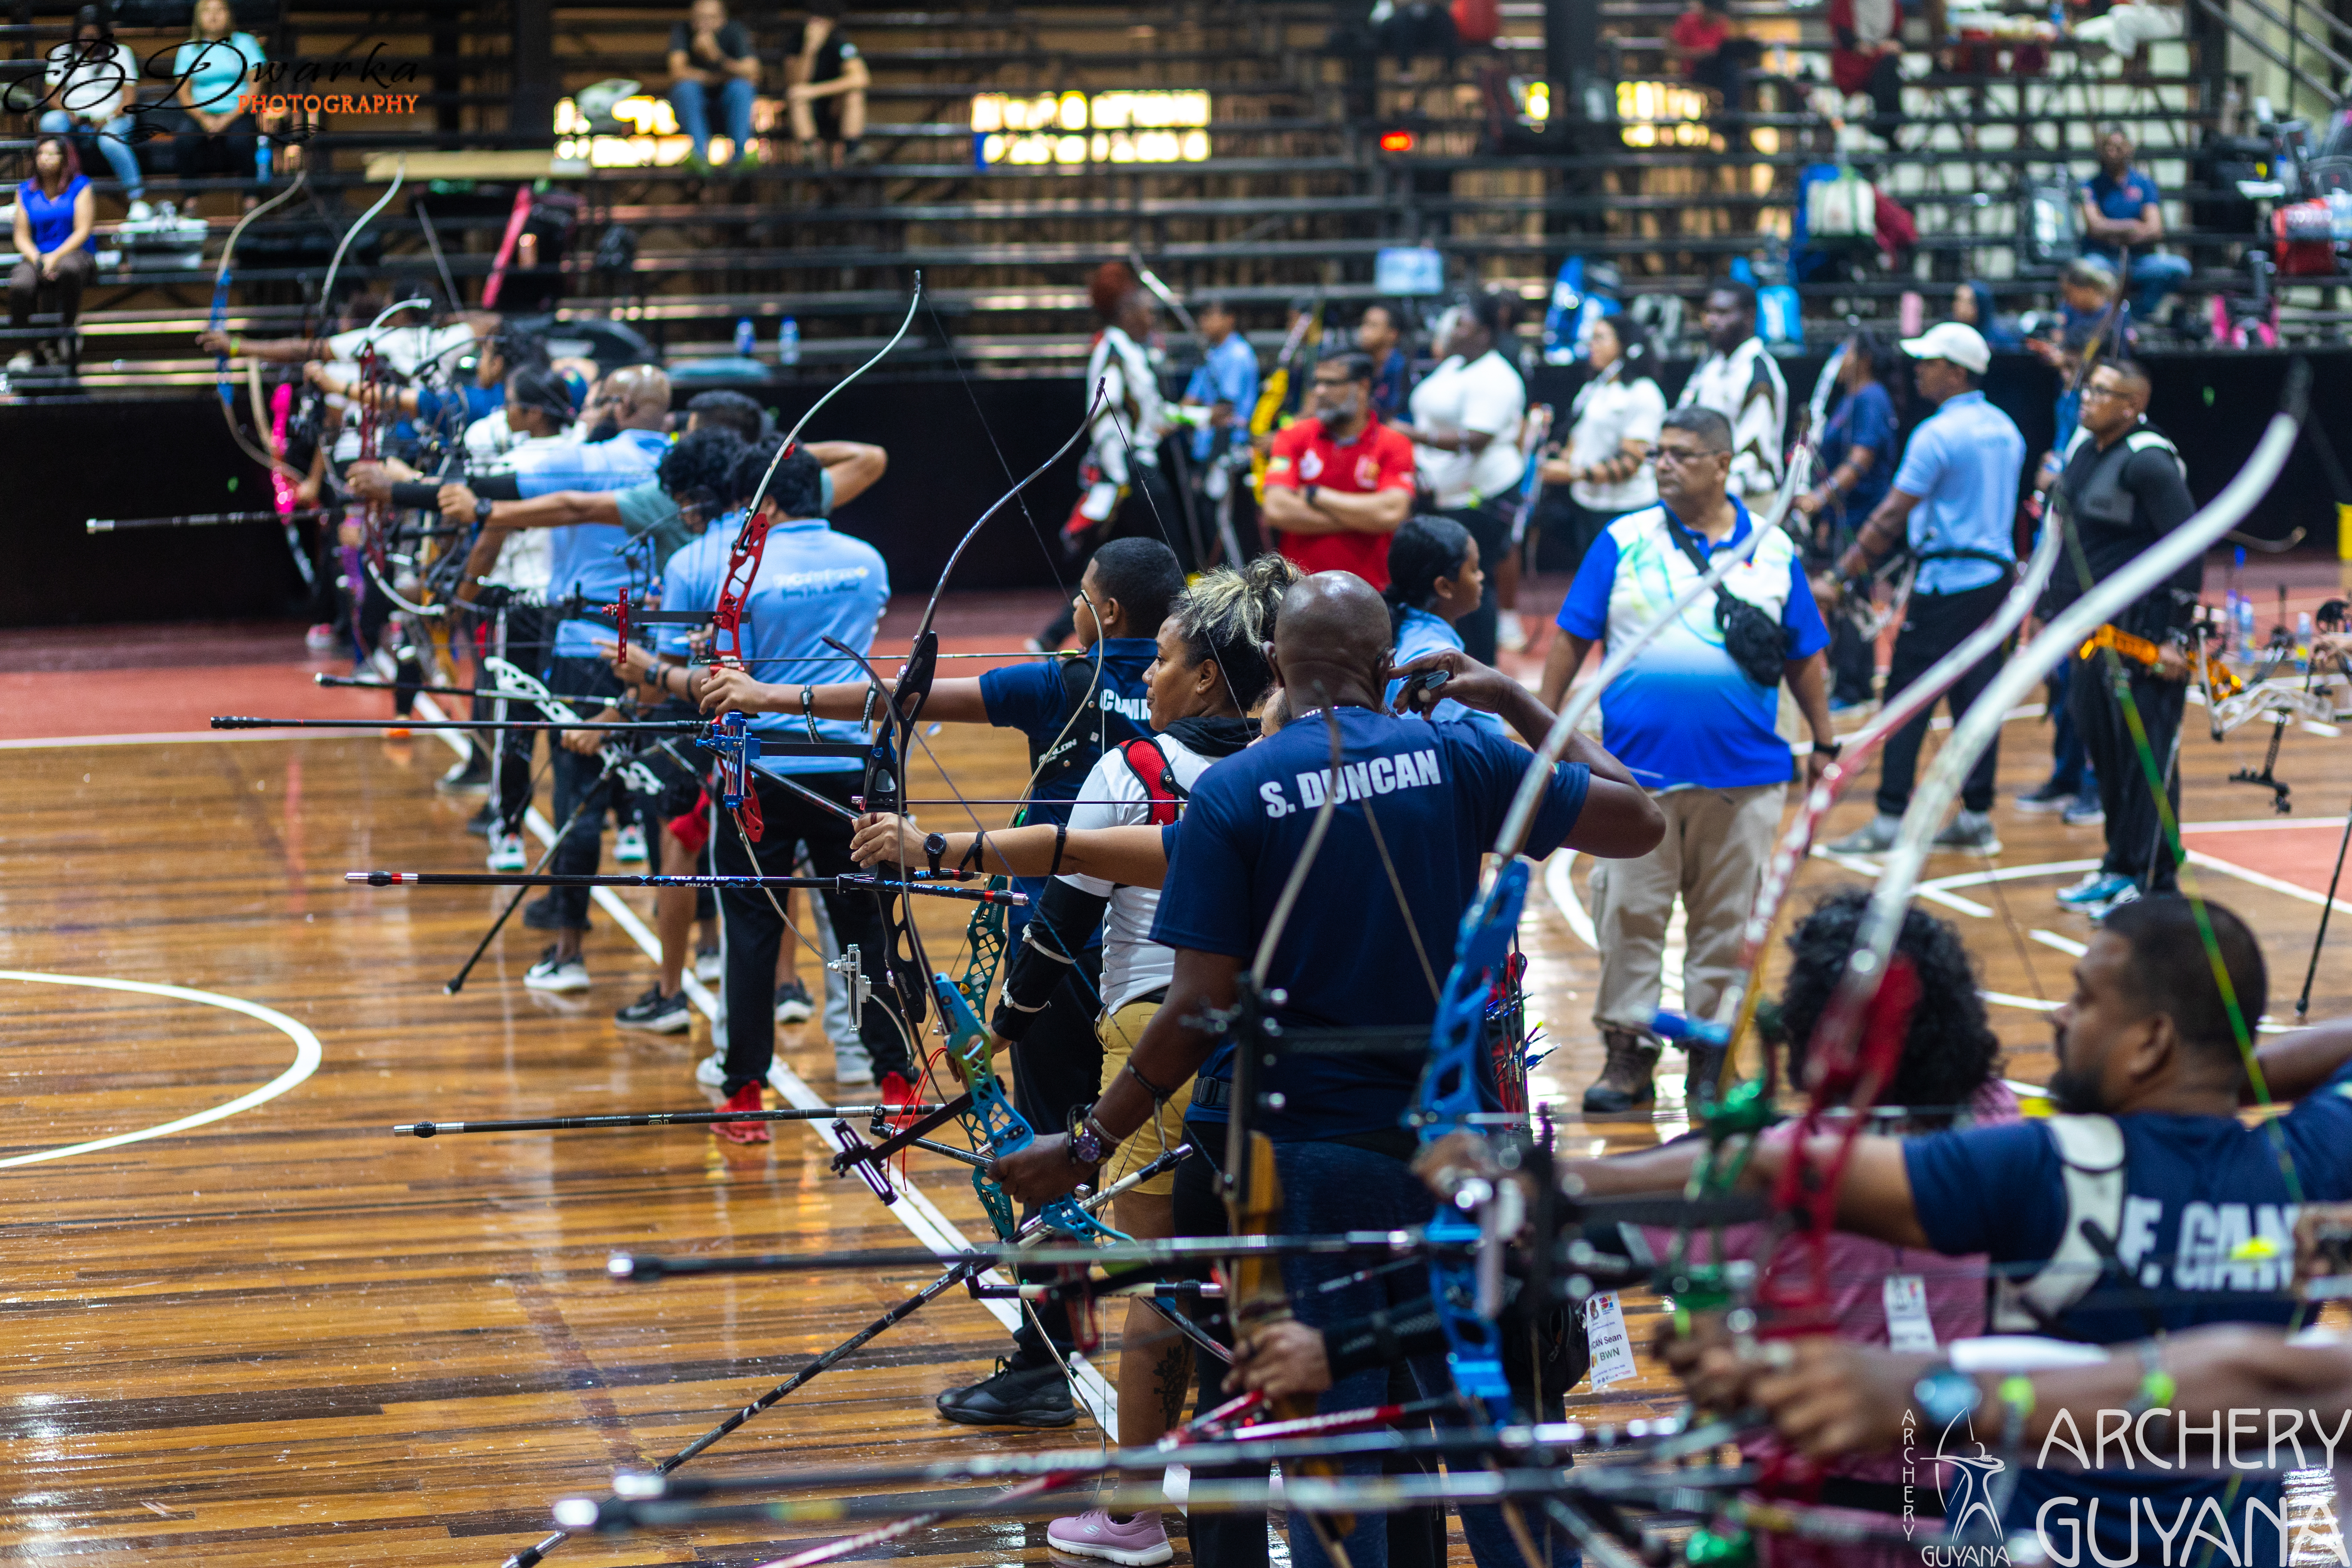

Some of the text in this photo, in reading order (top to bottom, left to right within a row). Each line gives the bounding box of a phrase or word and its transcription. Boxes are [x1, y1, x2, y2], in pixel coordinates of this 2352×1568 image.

[937, 510, 990, 587] TOPOINT
[1259, 749, 1442, 818] S. DUNCAN
[2117, 1195, 2163, 1289] F.
[1591, 1334, 1622, 1350] CAN Sean
[1599, 1347, 1620, 1361] BWN
